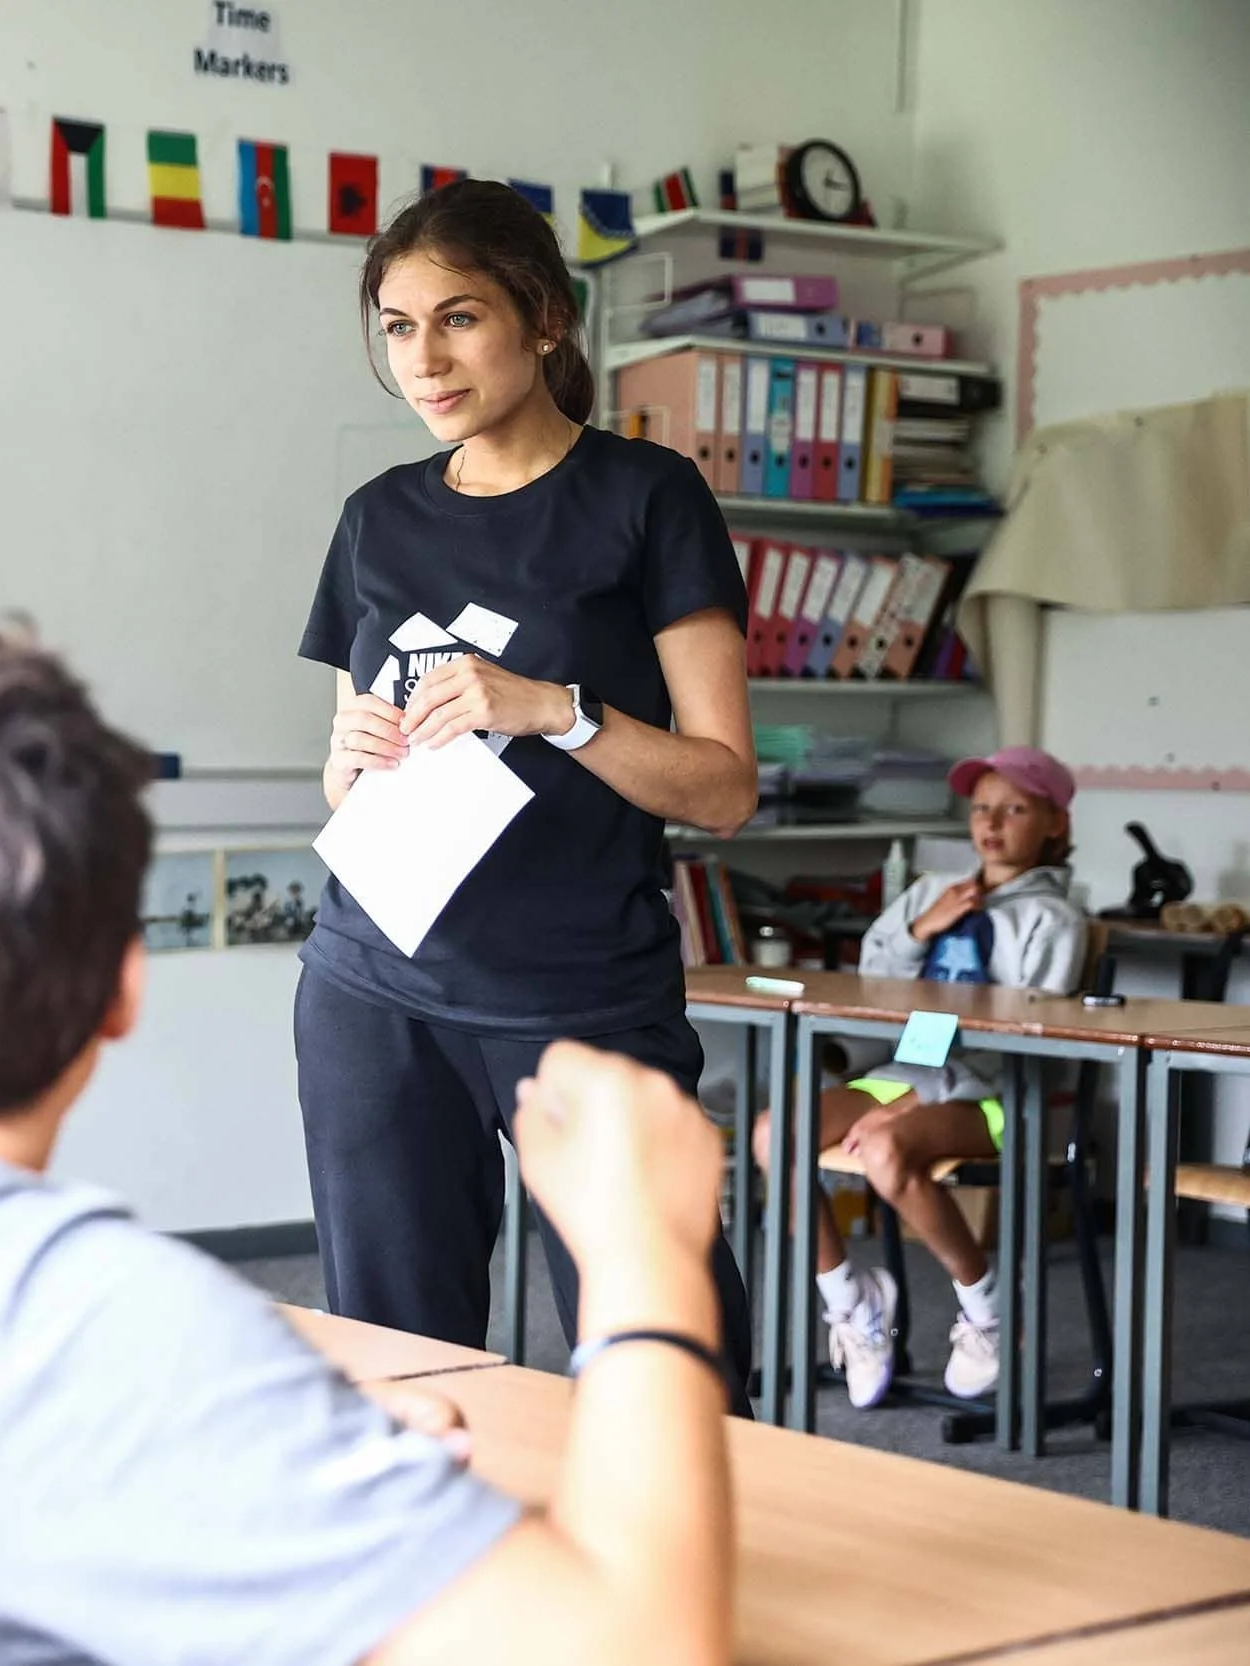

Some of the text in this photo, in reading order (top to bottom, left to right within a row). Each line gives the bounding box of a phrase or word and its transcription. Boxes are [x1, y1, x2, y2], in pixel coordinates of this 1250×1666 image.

[213, 0, 271, 32] Time
[193, 49, 290, 84] Markers
[407, 652, 465, 678] NIK
